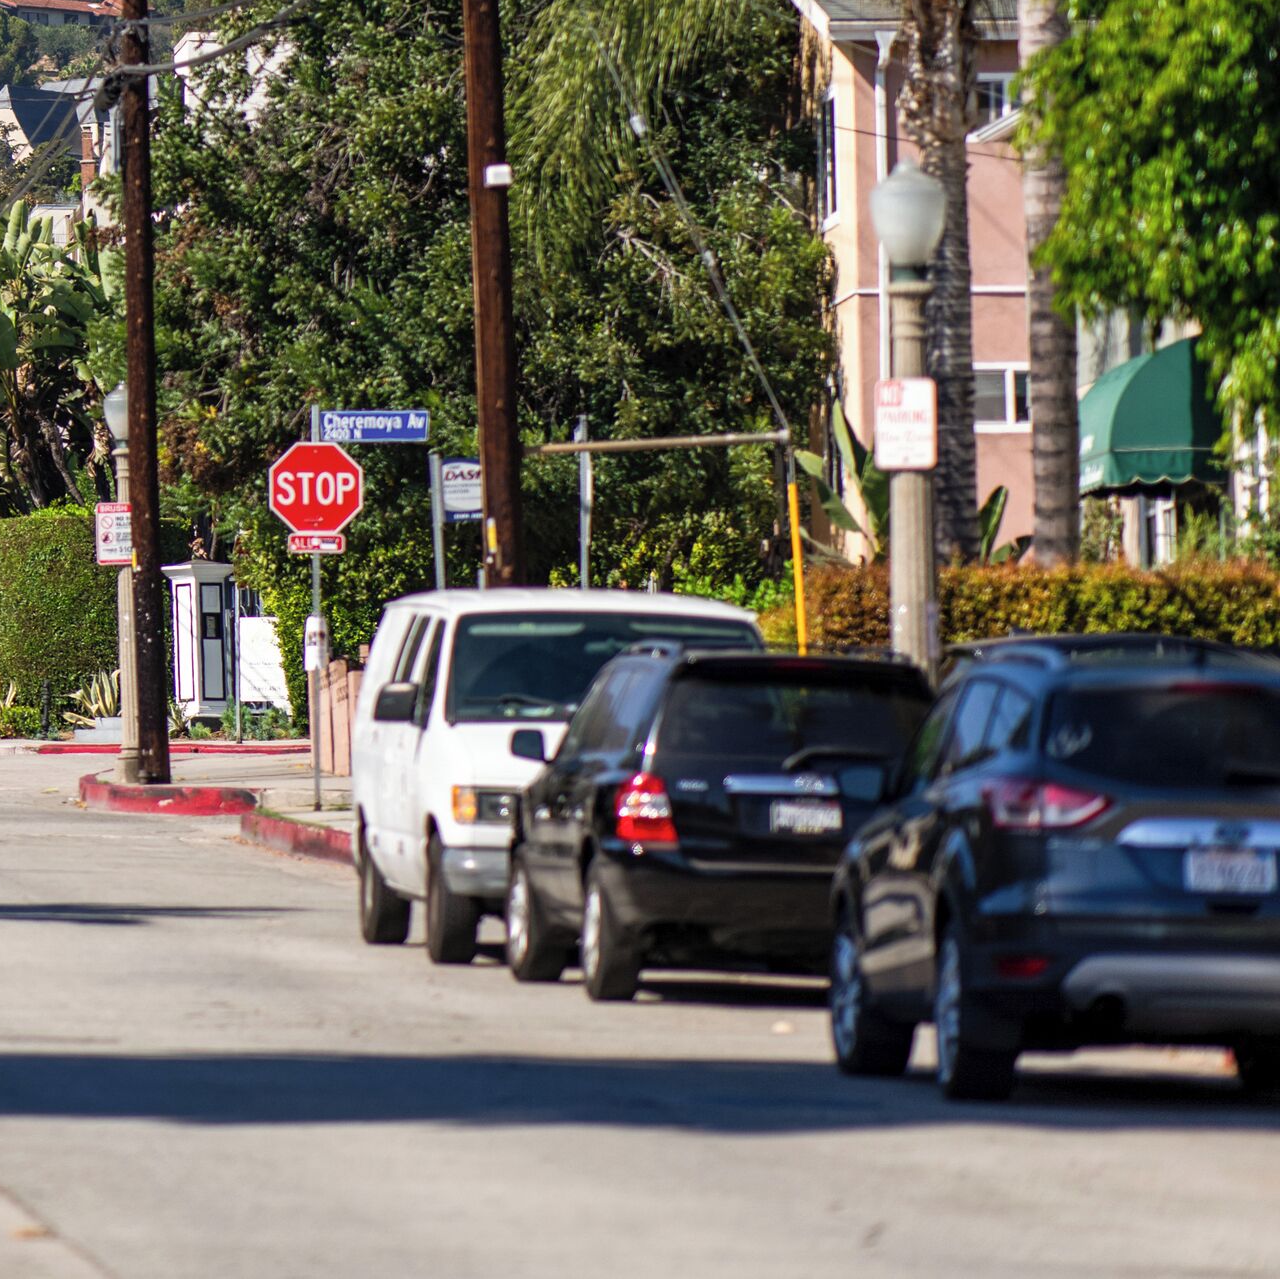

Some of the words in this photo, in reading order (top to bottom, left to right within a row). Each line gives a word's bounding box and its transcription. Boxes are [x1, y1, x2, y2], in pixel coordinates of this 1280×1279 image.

[324, 413, 403, 433] Cheremoya
[407, 413, 426, 429] Av
[276, 471, 356, 506] STOP
[100, 504, 129, 513] BRUSH
